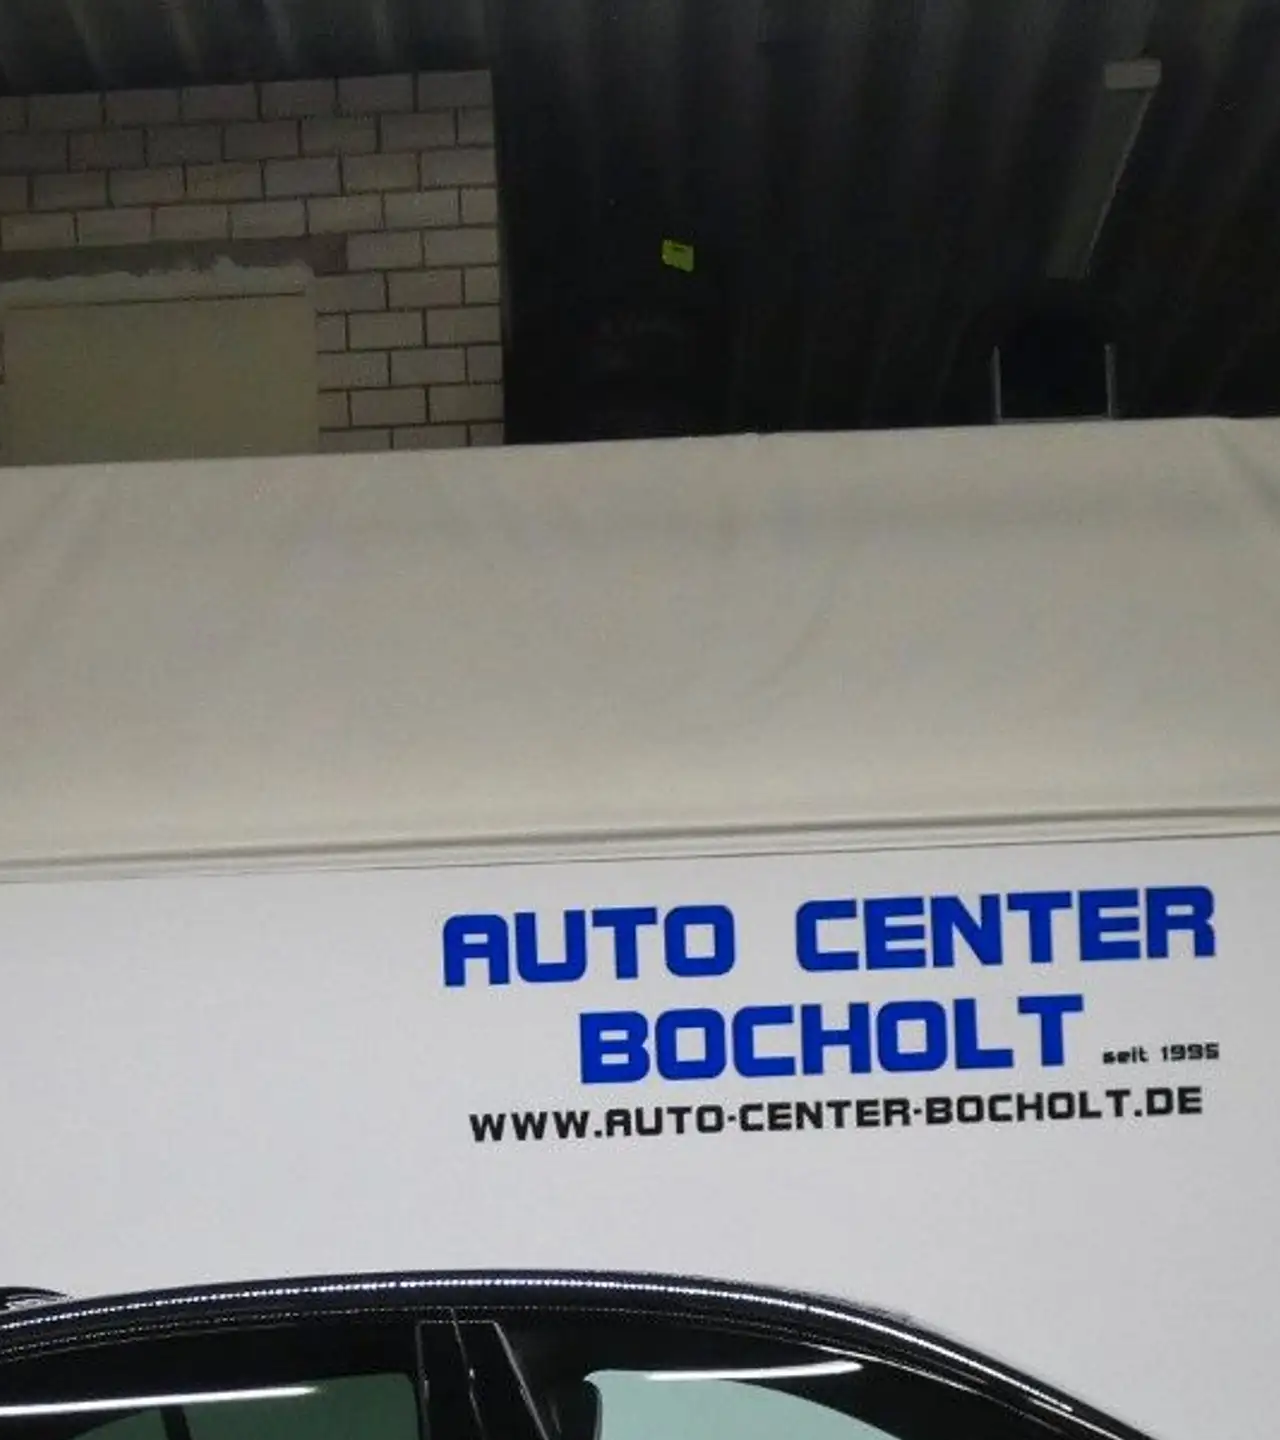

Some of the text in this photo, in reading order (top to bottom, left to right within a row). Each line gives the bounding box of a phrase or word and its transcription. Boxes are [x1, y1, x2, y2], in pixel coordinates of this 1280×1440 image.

[443, 886, 1217, 987] AUTO CENTER
[580, 994, 1085, 1084] BOCHOLT
[1103, 1043, 1220, 1064] seit 1995
[469, 1086, 1204, 1142] WWW.AUTO-CENTER-BOCHOLT.DE
